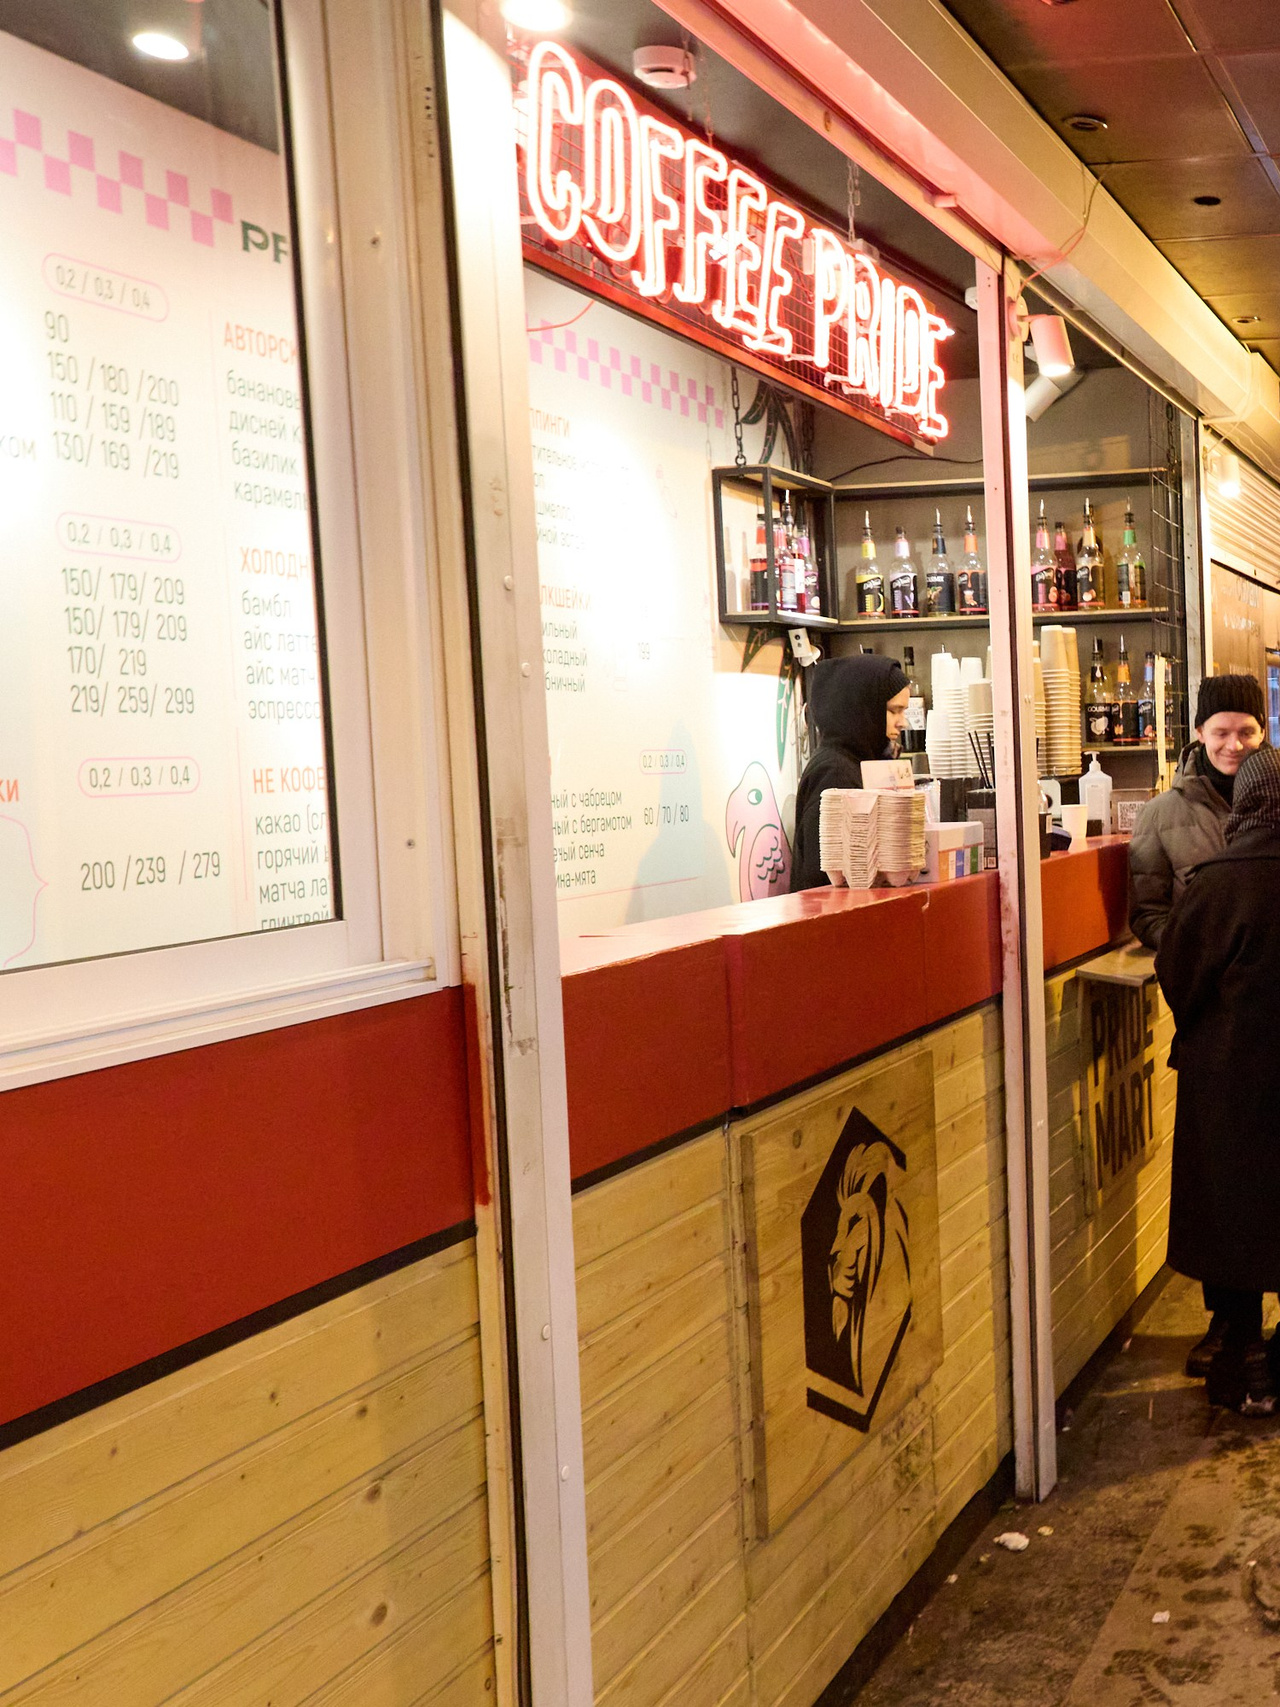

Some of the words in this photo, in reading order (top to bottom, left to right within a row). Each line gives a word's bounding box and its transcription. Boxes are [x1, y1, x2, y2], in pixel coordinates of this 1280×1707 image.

[526, 40, 806, 356] COFFEE
[811, 226, 956, 438] PRIDE
[43, 310, 70, 343] 90
[229, 410, 288, 441] дисней
[231, 440, 299, 477] базилик
[67, 521, 91, 545] 0,2
[109, 527, 133, 551] 0,3
[151, 532, 173, 556] 0,4
[153, 576, 186, 606] 209
[241, 590, 291, 618] бамбл
[156, 613, 188, 643] 209
[243, 626, 273, 653] айс
[119, 648, 148, 677] 219
[246, 660, 275, 686] айс
[164, 687, 195, 715] 299
[89, 767, 112, 791] 0,2
[130, 766, 153, 789] 0,3
[170, 765, 191, 786] 0,4
[252, 768, 276, 794] НЕ
[579, 788, 623, 812] чабрецом
[255, 813, 301, 836] какао
[580, 814, 633, 837] бергамотом
[257, 840, 319, 873] горячий
[579, 842, 606, 861] сенча
[259, 880, 306, 905] матча
[310, 875, 331, 897] ла
[1091, 984, 1154, 1087] PRIDE
[1094, 1058, 1155, 1190] MART
